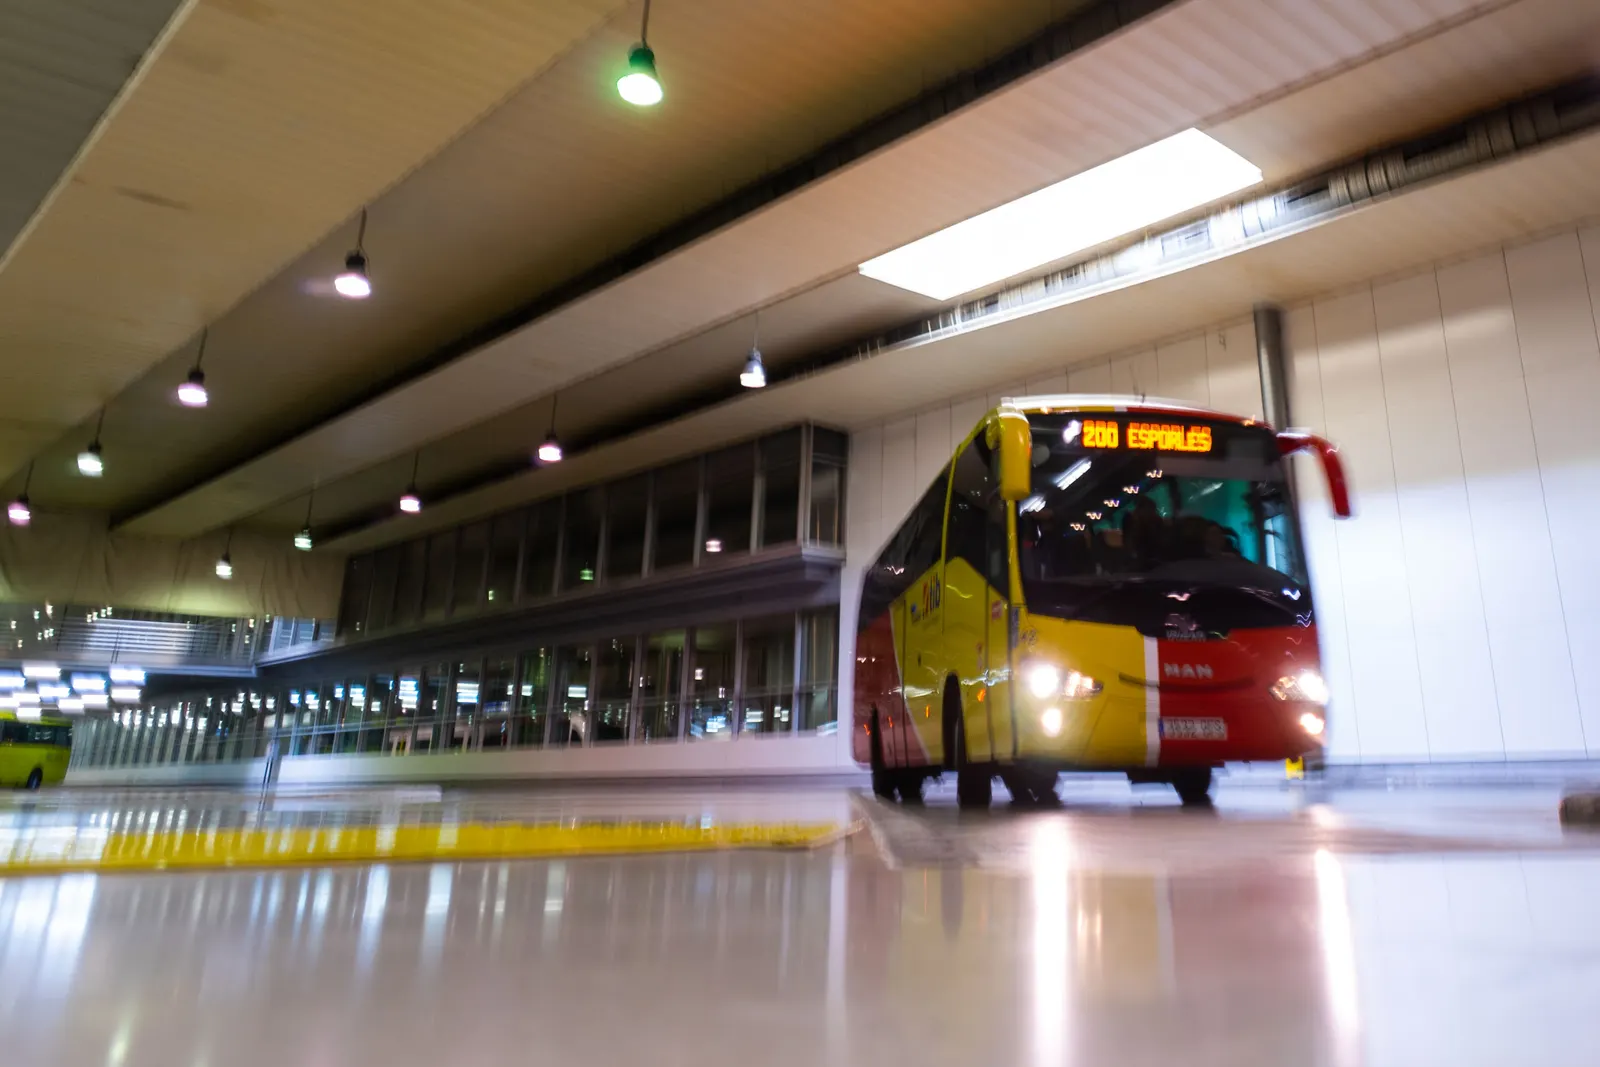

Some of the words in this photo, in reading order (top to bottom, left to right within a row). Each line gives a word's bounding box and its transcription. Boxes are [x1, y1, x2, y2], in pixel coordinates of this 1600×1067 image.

[1083, 420, 1118, 448] 200
[1127, 422, 1212, 452] ESPORLES
[1163, 662, 1213, 679] MAN
